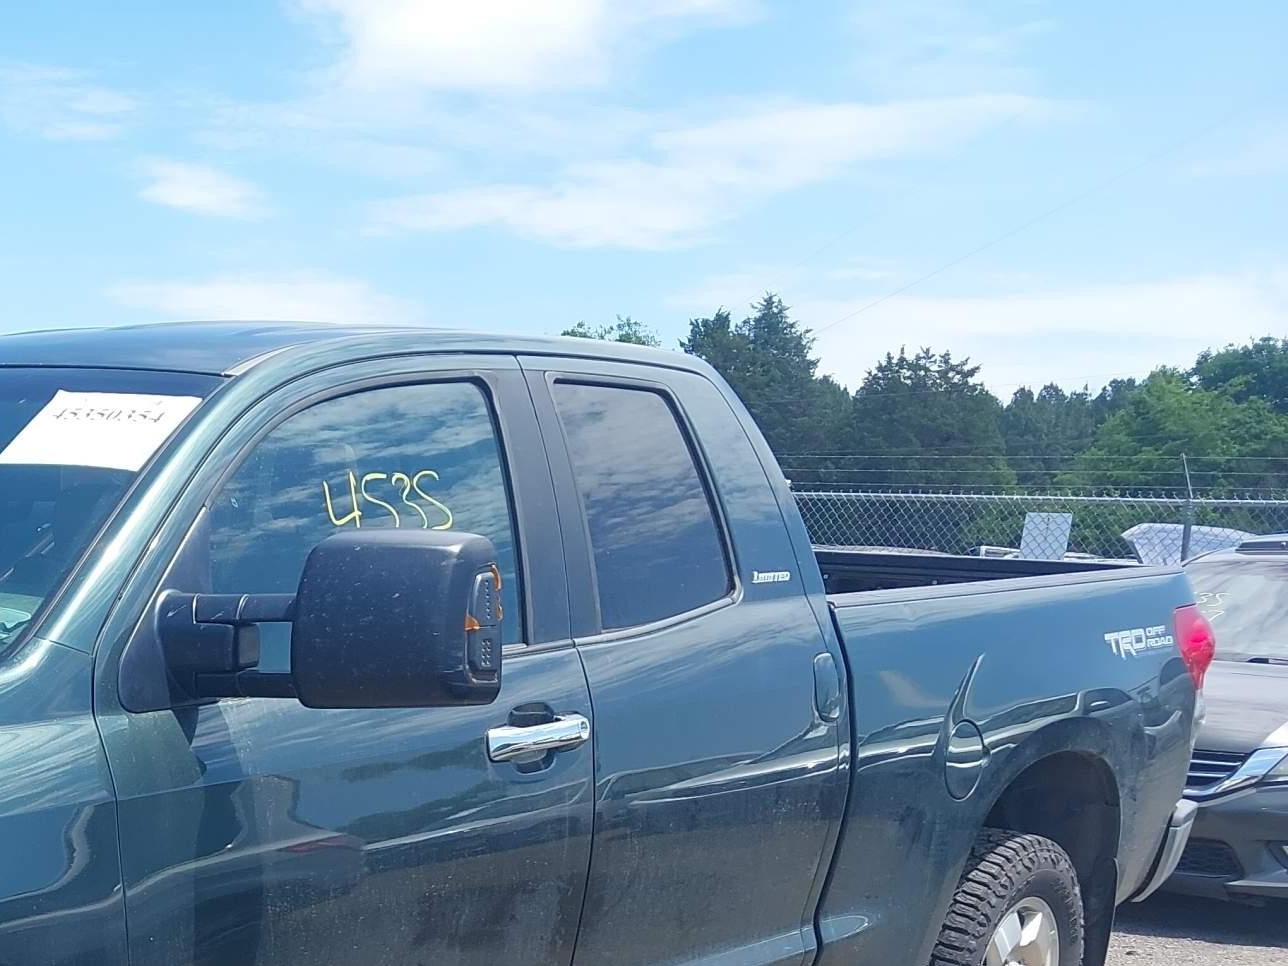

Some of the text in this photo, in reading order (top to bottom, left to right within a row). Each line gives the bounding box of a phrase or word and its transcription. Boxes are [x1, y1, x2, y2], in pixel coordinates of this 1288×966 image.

[323, 470, 453, 530] 4535
[1104, 625, 1166, 660] TRD OFF
[1146, 635, 1174, 648] ROAD
